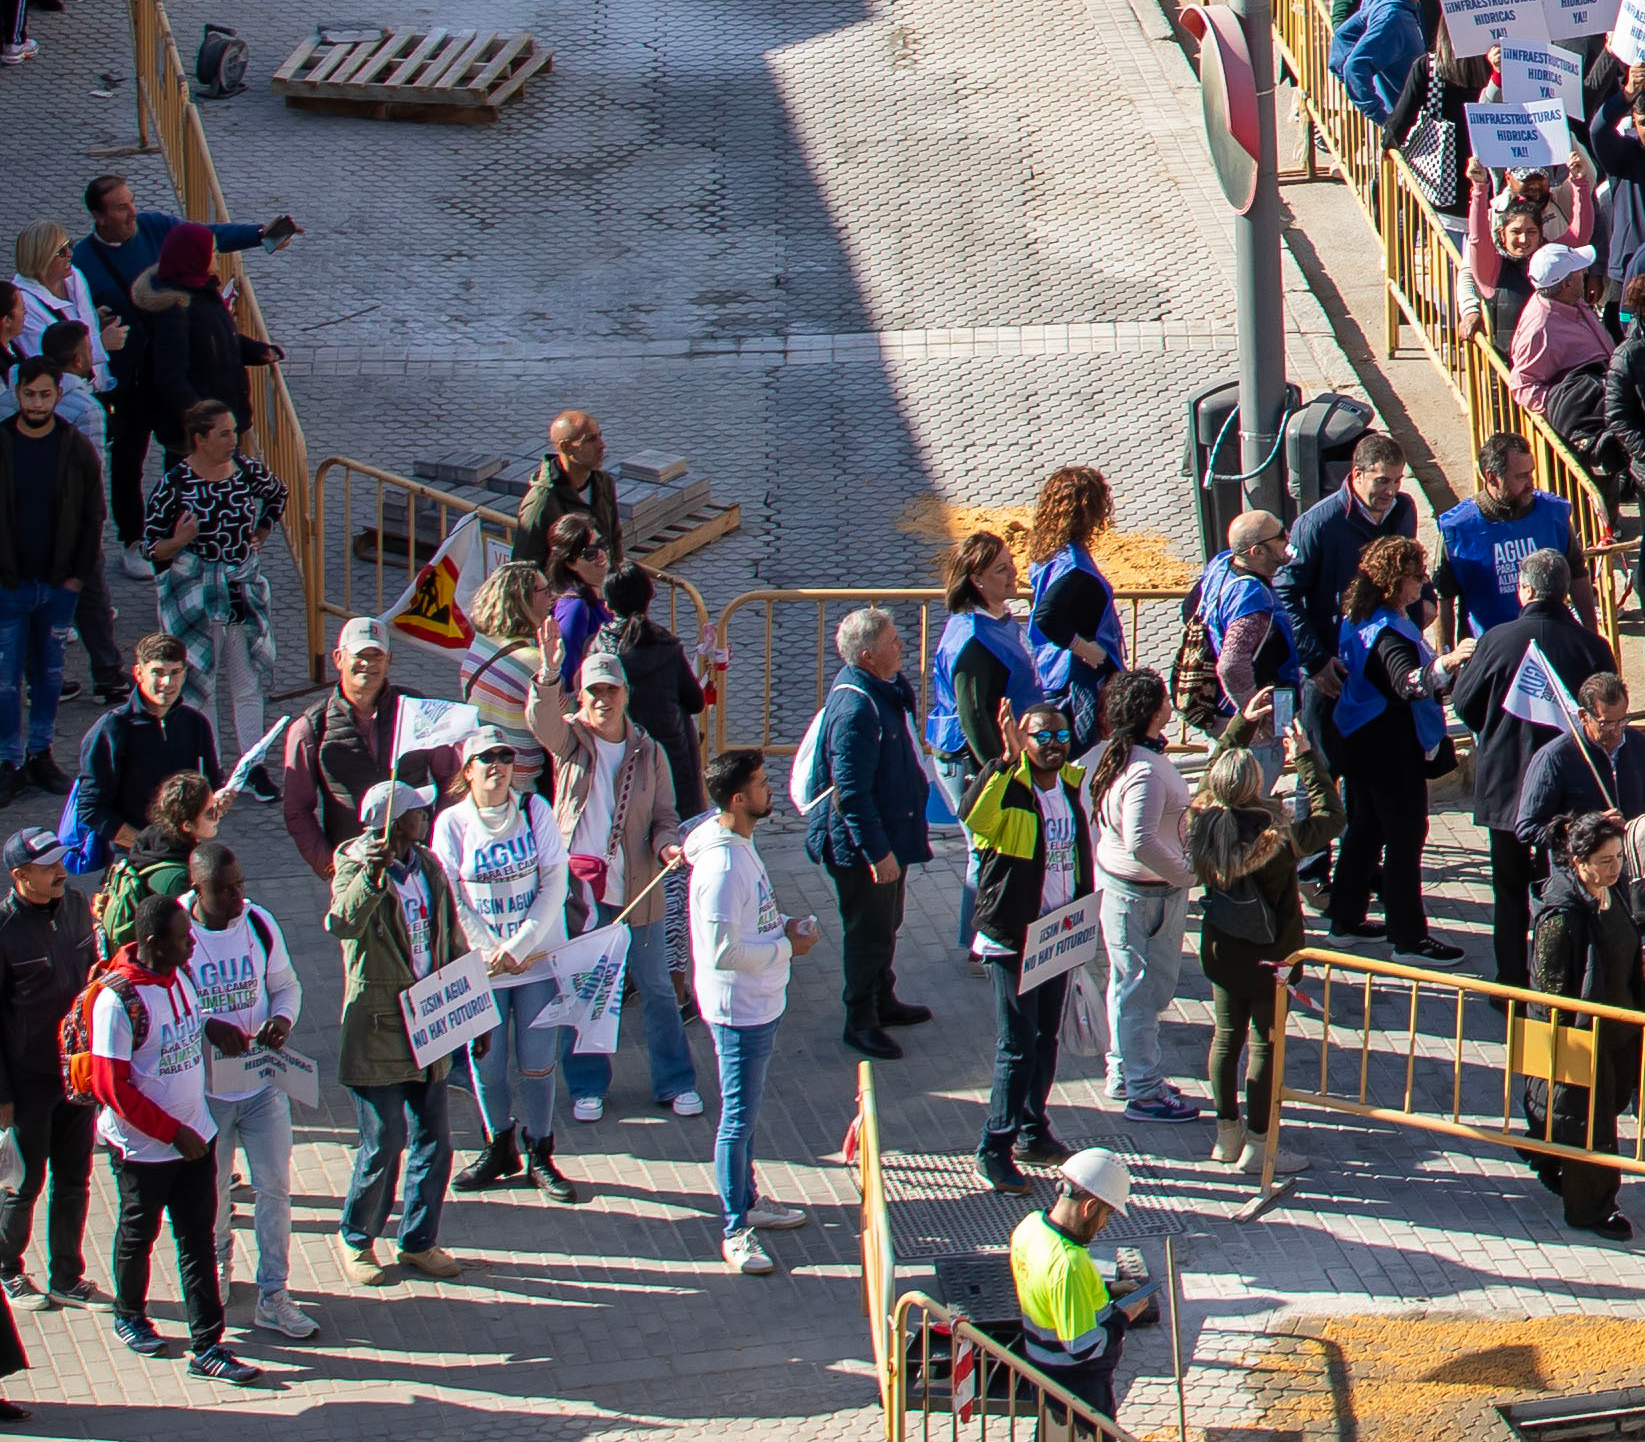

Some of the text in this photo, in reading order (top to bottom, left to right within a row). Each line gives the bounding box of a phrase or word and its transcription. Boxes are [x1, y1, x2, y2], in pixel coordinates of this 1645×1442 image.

[1496, 129, 1538, 142] HIDRICAS
[1511, 146, 1529, 158] YA!!
[473, 829, 537, 873] AGUA
[444, 976, 471, 1004] AGUA
[412, 1028, 431, 1050] NO
[431, 1017, 449, 1042] HAY
